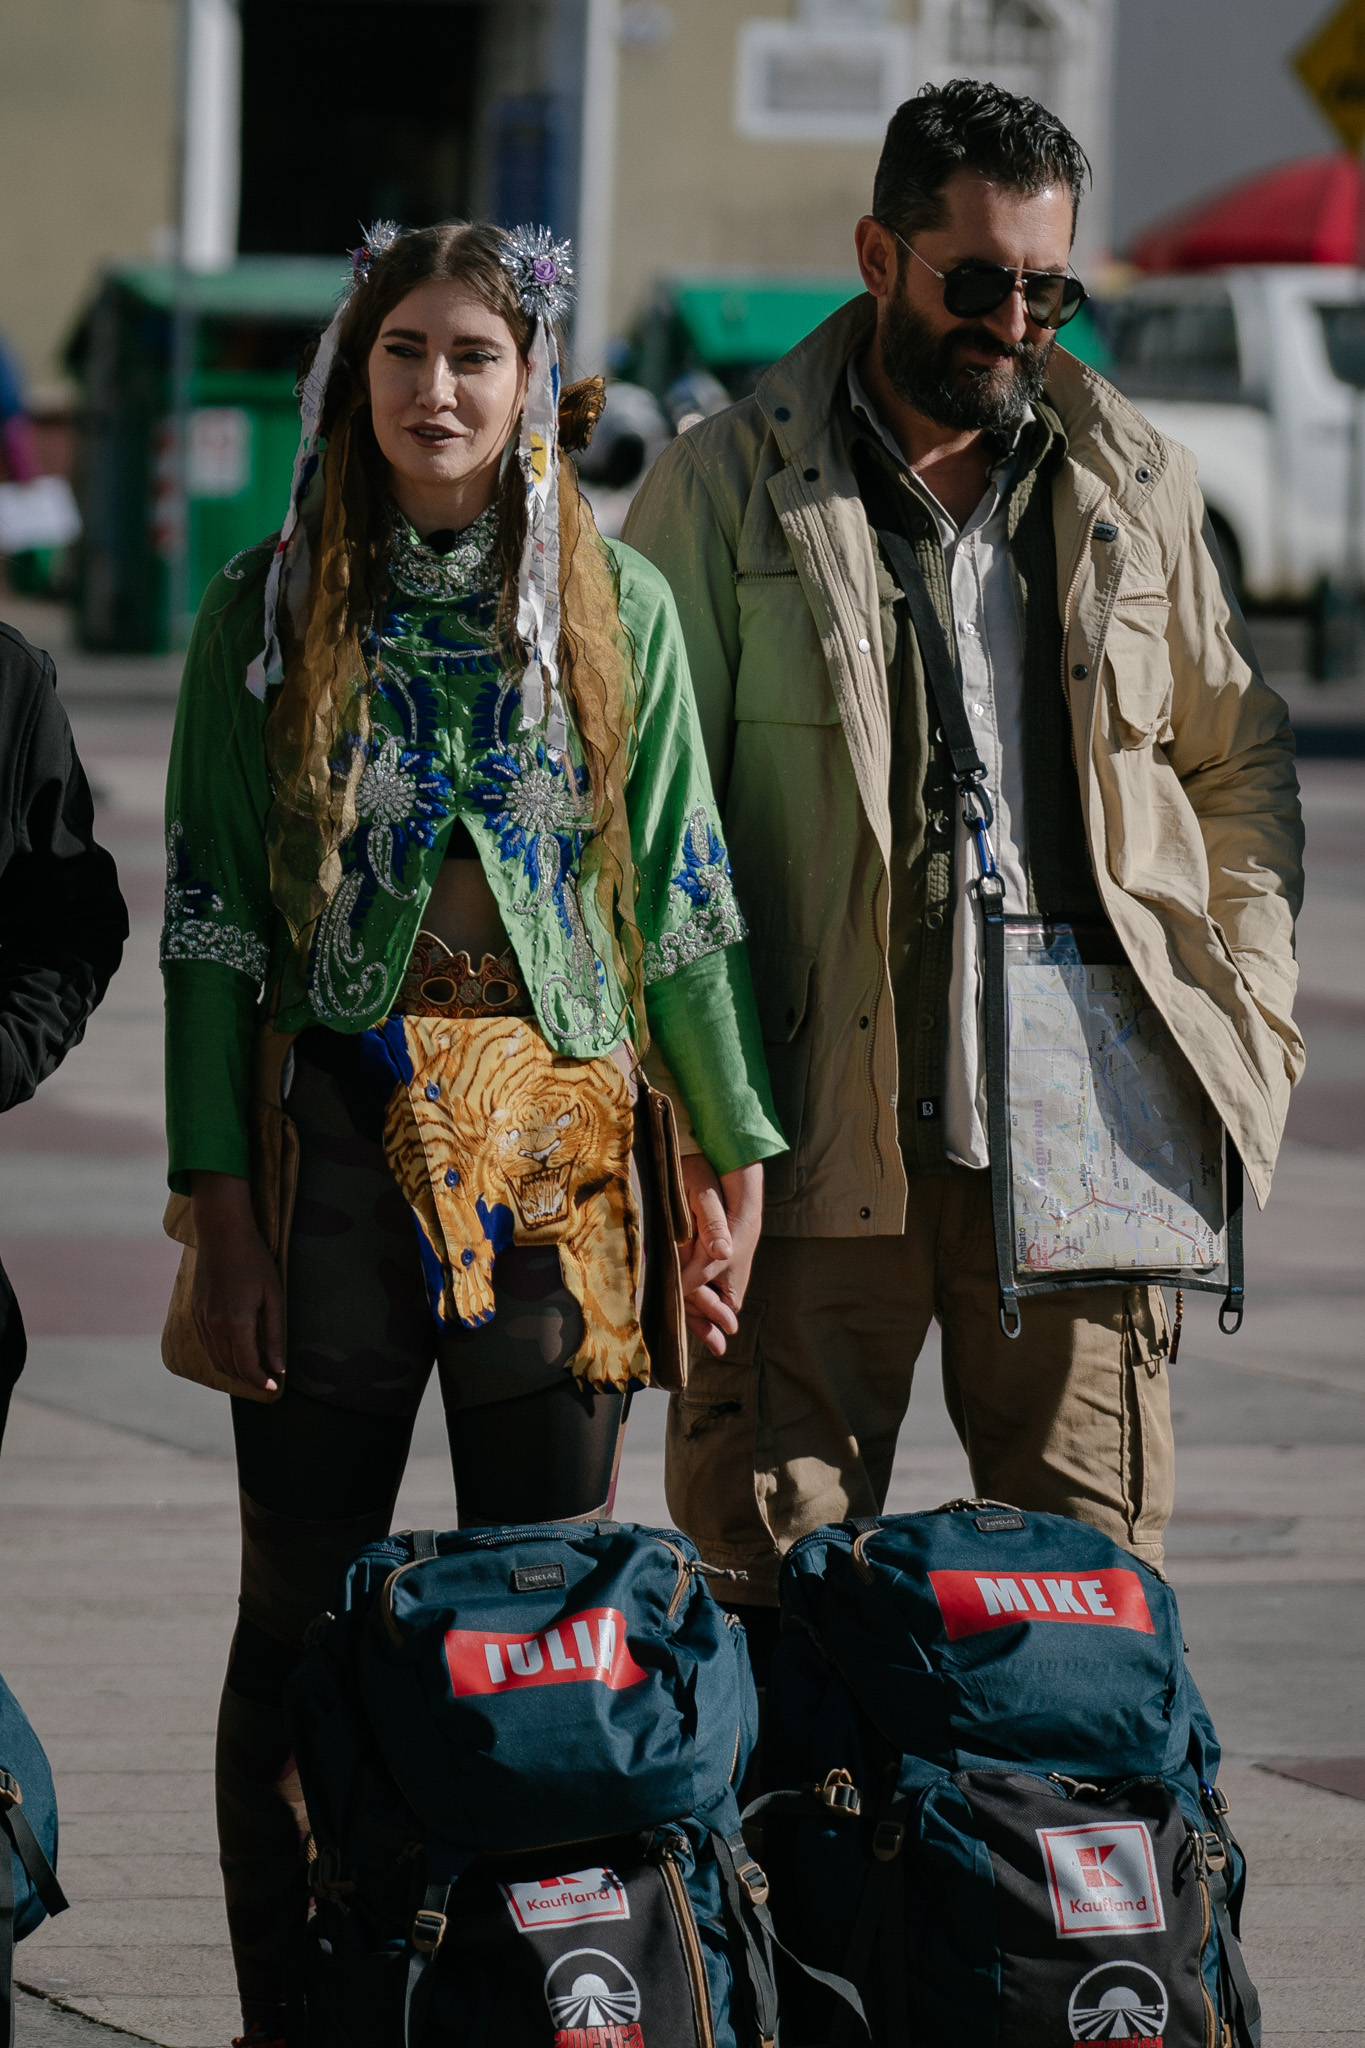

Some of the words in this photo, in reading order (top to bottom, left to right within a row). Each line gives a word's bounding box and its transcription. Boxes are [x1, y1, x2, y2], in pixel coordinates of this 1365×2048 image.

[1032, 1099, 1046, 1196] Tungurahua
[1018, 1227, 1027, 1261] Ambato
[525, 1572, 558, 1583] FORCLAZ
[975, 1577, 1115, 1616] MIKE
[526, 1888, 611, 1911] Kaufland
[1070, 1896, 1147, 1913] Kaufland
